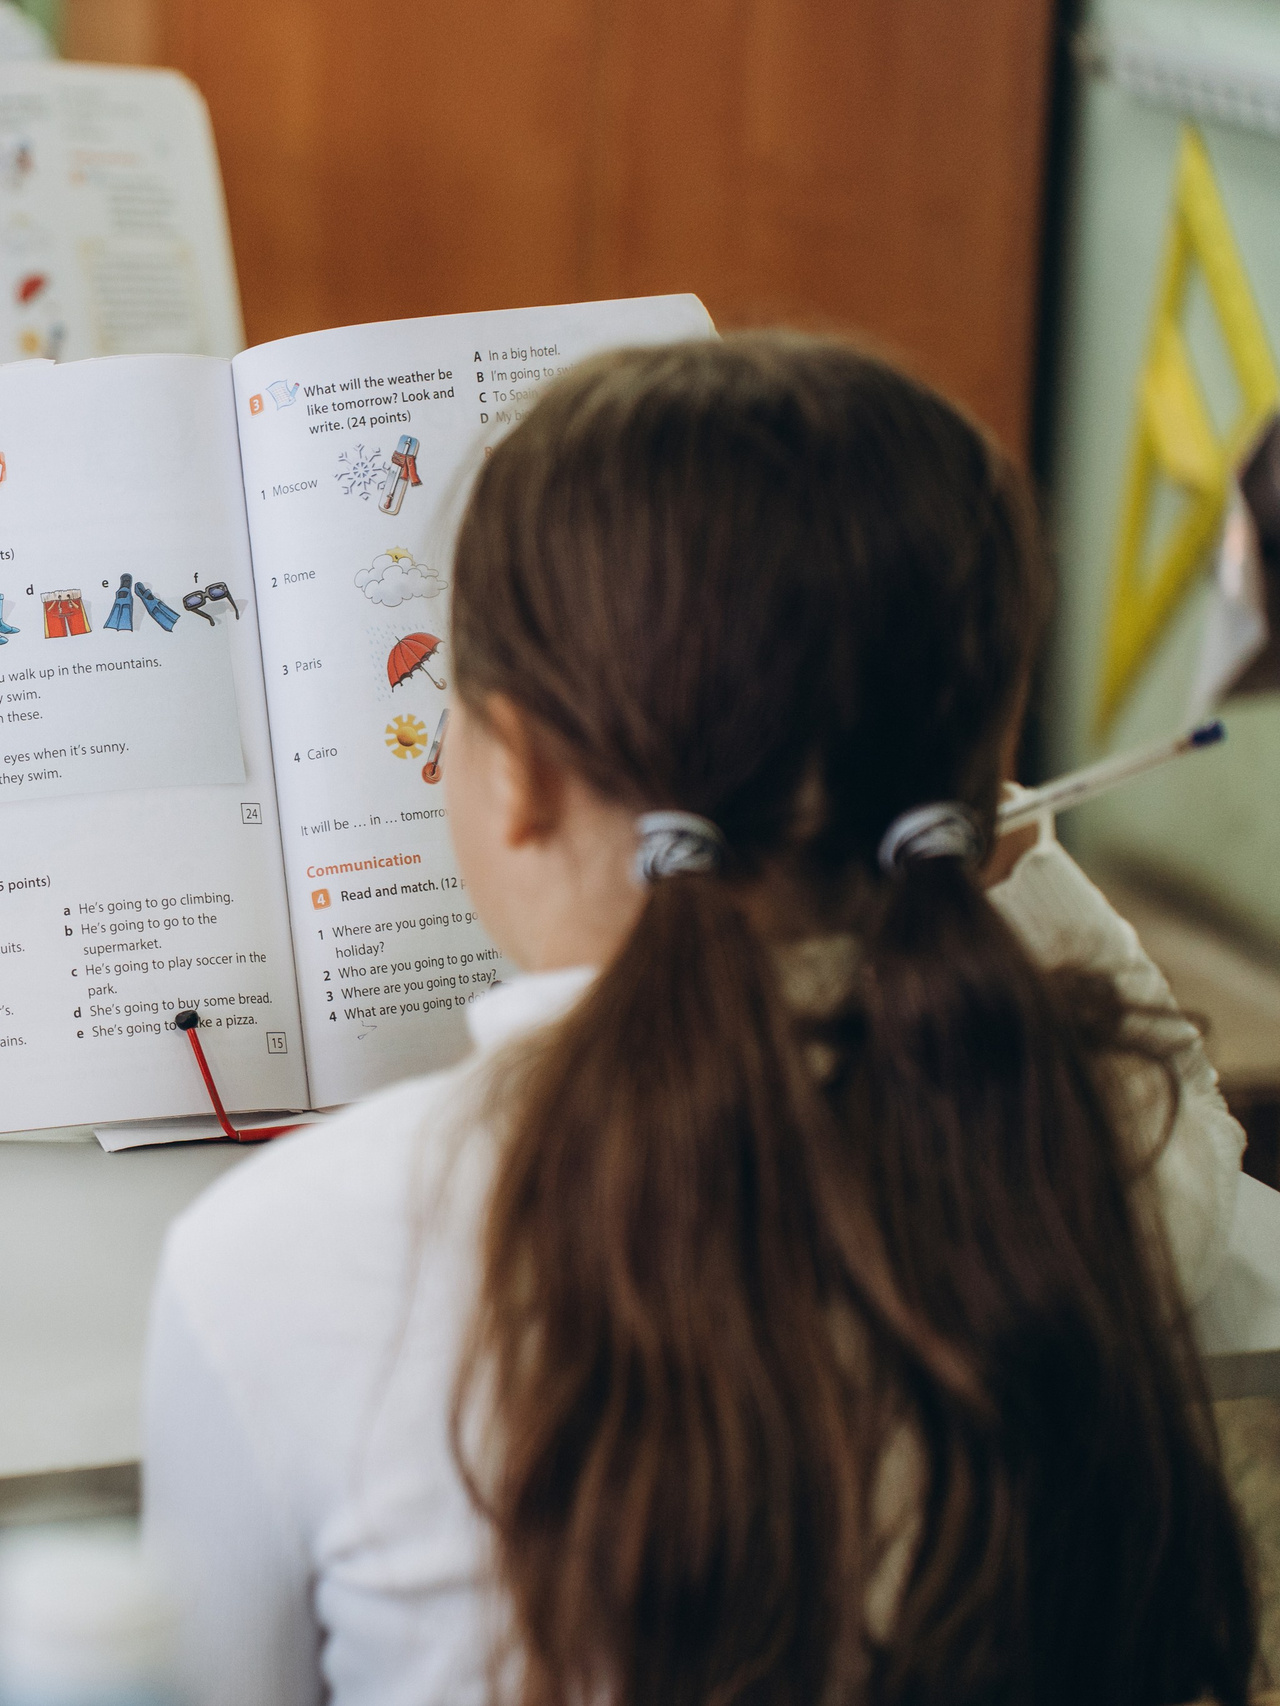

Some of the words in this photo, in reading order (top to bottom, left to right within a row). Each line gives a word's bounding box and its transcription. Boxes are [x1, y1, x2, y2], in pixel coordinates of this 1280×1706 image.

[473, 350, 482, 362] A
[488, 350, 498, 361] In
[501, 351, 507, 360] a
[510, 347, 527, 361] big
[529, 344, 560, 357] hotel.
[253, 399, 260, 411] 3
[303, 383, 336, 397] What
[339, 377, 361, 391] will
[363, 375, 384, 388] the
[387, 370, 435, 385] weather
[437, 368, 452, 380] be
[306, 403, 328, 416] like
[331, 392, 397, 411] tomorrow?
[401, 388, 430, 402] Look
[433, 386, 454, 399] and
[308, 420, 343, 434] write.
[347, 415, 366, 429] (24
[369, 409, 411, 428] points)
[260, 489, 265, 500] 1
[272, 479, 317, 496] Moscow
[102, 580, 109, 588] e
[194, 572, 198, 583] f
[271, 576, 277, 588] 2
[283, 570, 315, 584] Rome
[26, 584, 34, 595] d
[8, 667, 36, 681] walk
[38, 668, 54, 680] up
[57, 665, 69, 676] in
[72, 662, 92, 674] the
[95, 657, 161, 671] mountains.
[282, 664, 288, 675] 3
[295, 658, 322, 672] Paris
[6, 689, 40, 702] swim.
[7, 710, 42, 722] these.
[3, 752, 30, 765] eyes
[33, 747, 66, 760] when
[69, 744, 87, 756] it's
[89, 742, 129, 754] sunny.
[293, 752, 300, 762] 4
[307, 747, 337, 760] Cairo
[27, 768, 61, 781] swim.
[246, 809, 258, 819] 24
[306, 852, 421, 878] Communication
[7, 874, 50, 893] points)
[63, 907, 71, 916] a
[78, 901, 104, 914] He's
[107, 899, 142, 914] going
[145, 897, 158, 908] to
[161, 897, 177, 910] go
[179, 891, 234, 905] climbing.
[83, 938, 161, 956] supermarket.
[335, 941, 384, 958] holiday?
[87, 982, 117, 999] park.
[73, 1006, 81, 1018] d
[89, 1003, 120, 1016] She's
[123, 1001, 158, 1016] going
[161, 999, 174, 1010] to
[177, 997, 200, 1010] buy
[203, 996, 235, 1007] some
[238, 992, 272, 1004] bread.
[272, 1038, 283, 1049] 15
